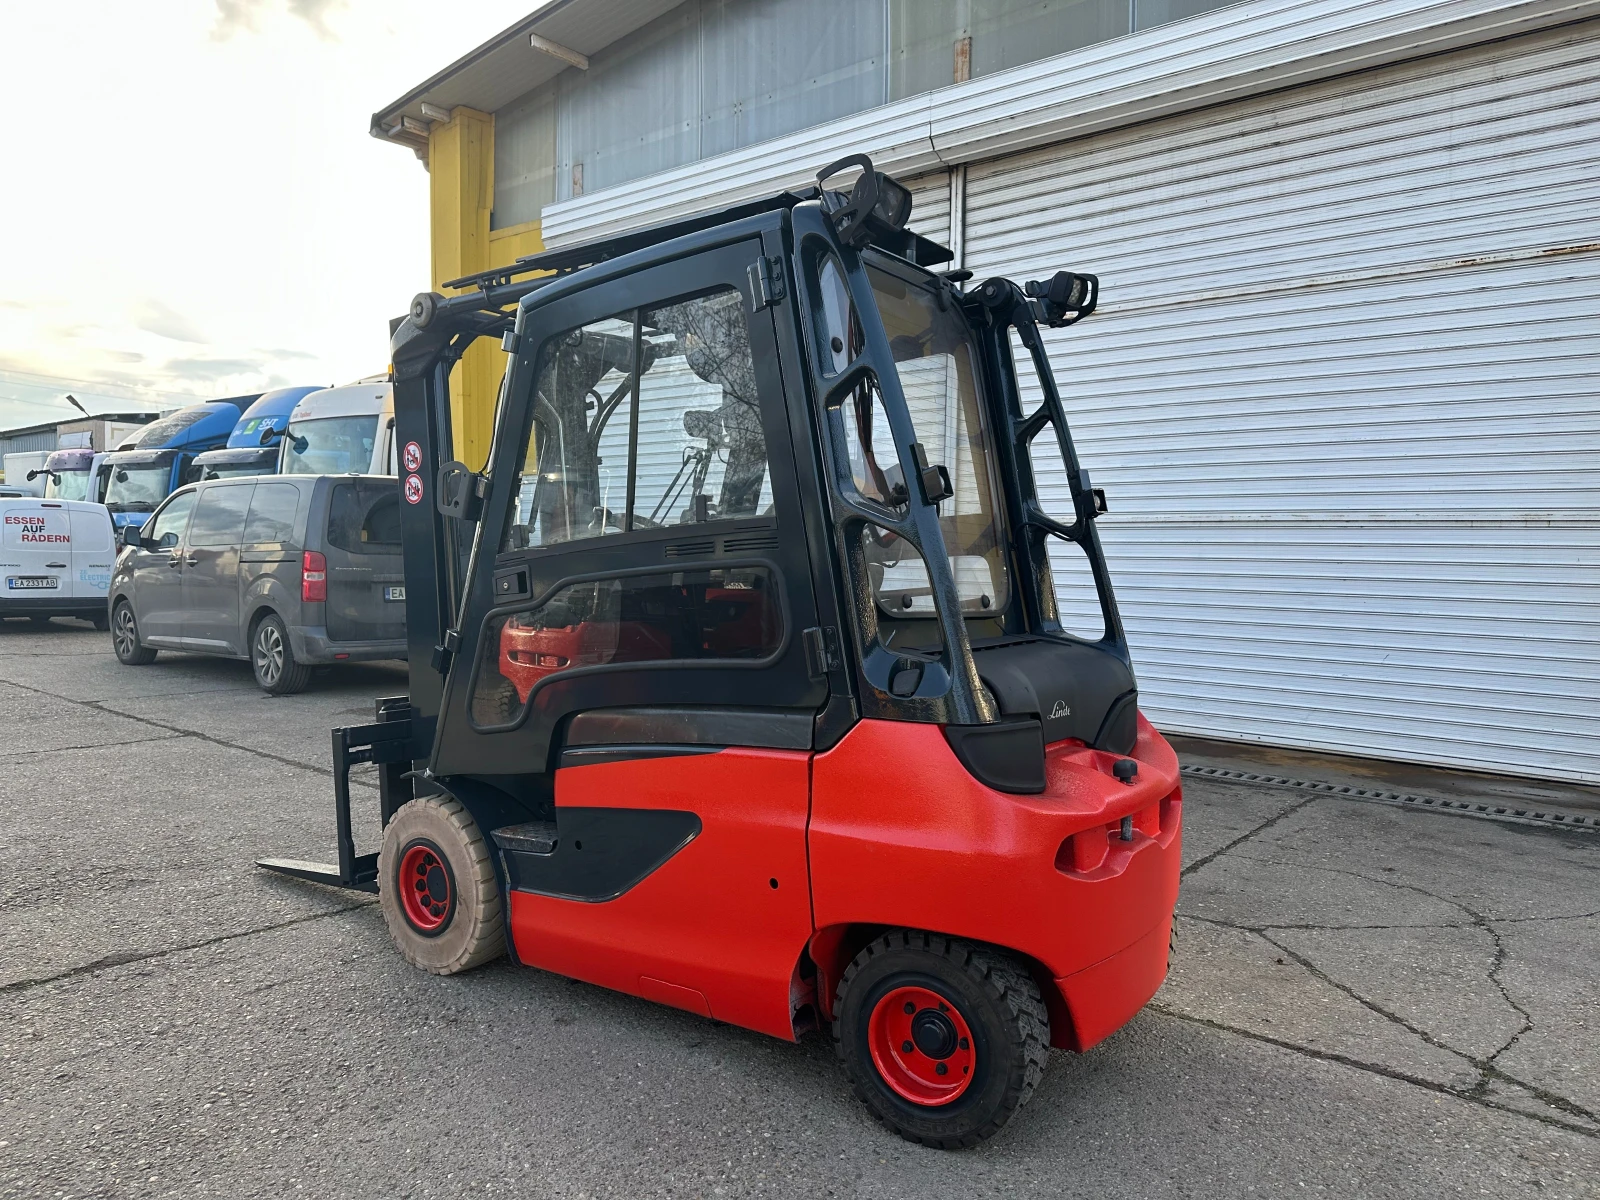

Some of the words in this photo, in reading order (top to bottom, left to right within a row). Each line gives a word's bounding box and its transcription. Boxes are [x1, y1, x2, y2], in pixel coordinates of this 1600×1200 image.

[5, 516, 45, 525] ESSEN
[22, 525, 45, 533] AUF
[22, 532, 70, 543] RÄDERN
[391, 588, 404, 599] EA
[1046, 699, 1072, 720] Linde
